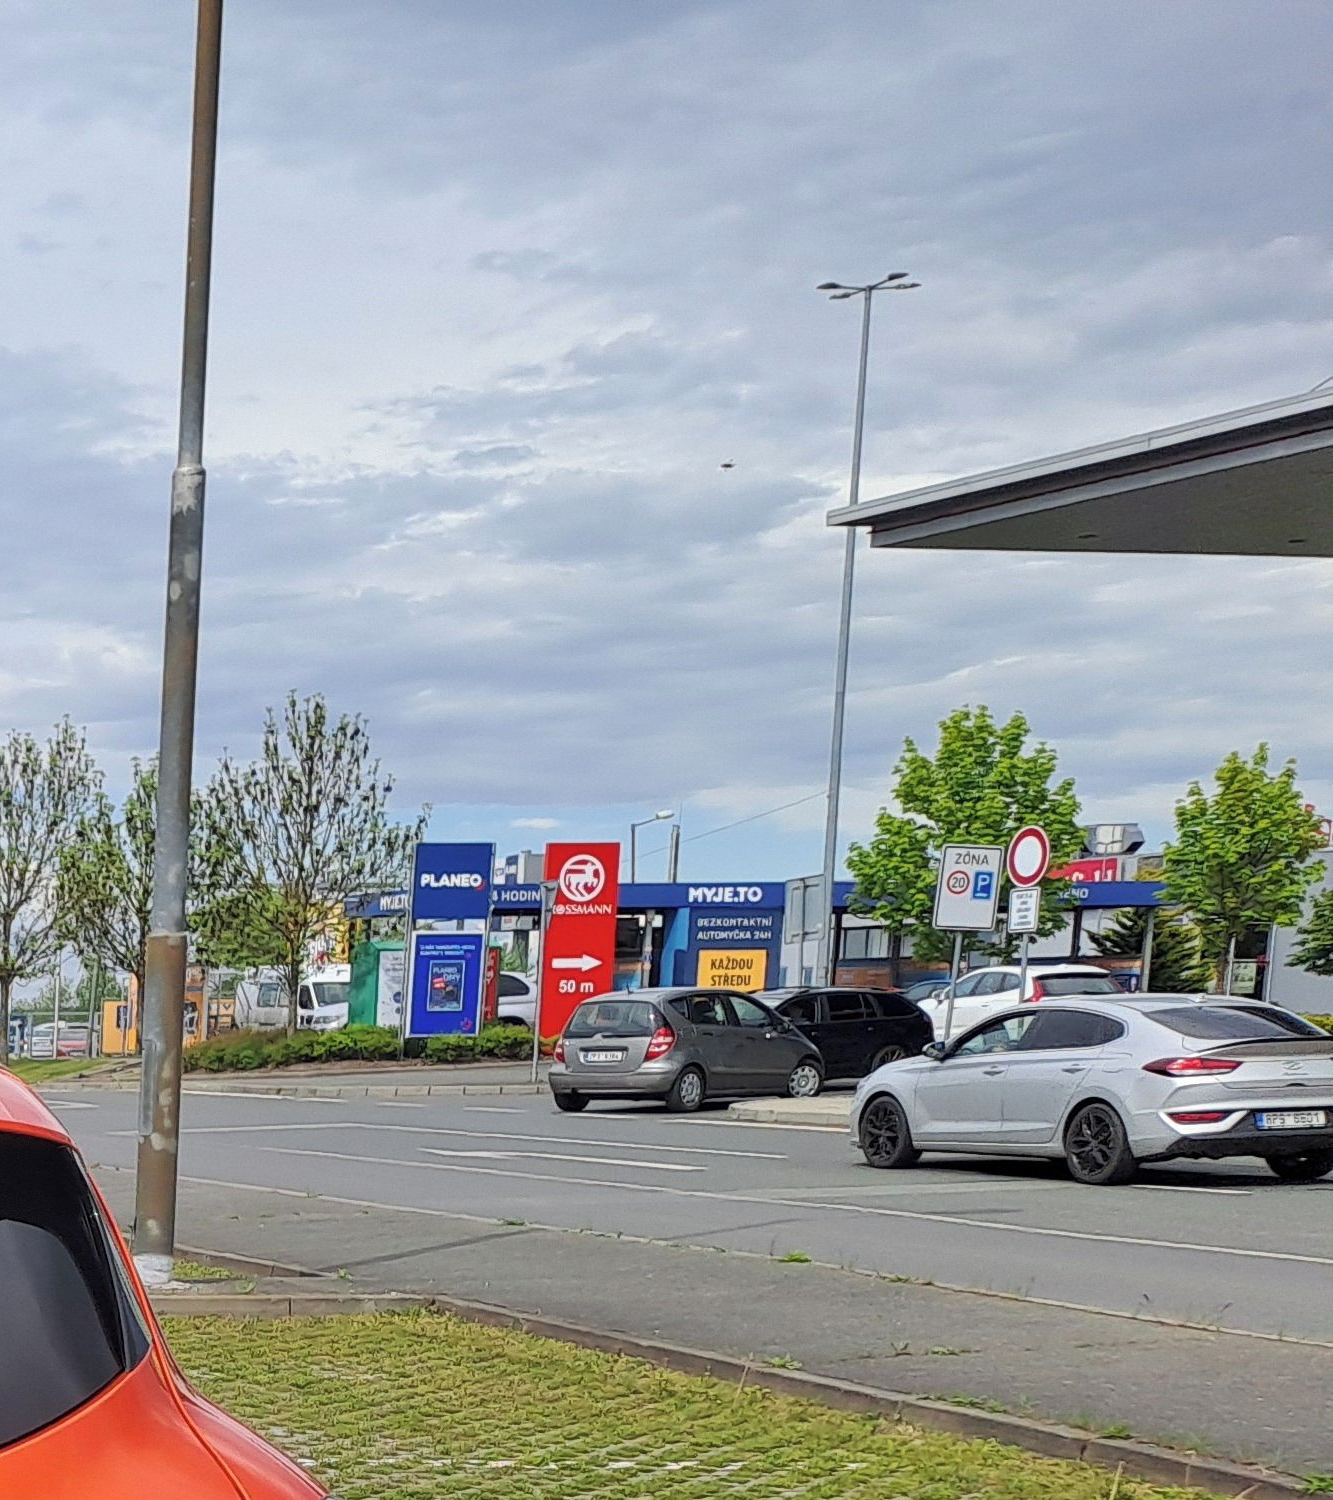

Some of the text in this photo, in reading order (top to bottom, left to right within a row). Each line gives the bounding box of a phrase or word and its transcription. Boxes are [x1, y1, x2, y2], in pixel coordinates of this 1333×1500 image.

[954, 851, 989, 866] ZÓNA
[420, 873, 482, 888] PLANEO
[951, 876, 966, 888] 20
[688, 886, 763, 903] MYJE.TO
[697, 915, 773, 927] BEZKONTAKTNÍ
[696, 929, 751, 940] AUTOMYČKA
[710, 956, 754, 970] KAŽDOU
[558, 979, 594, 993] 50 m
[710, 972, 751, 987] STŘEDU
